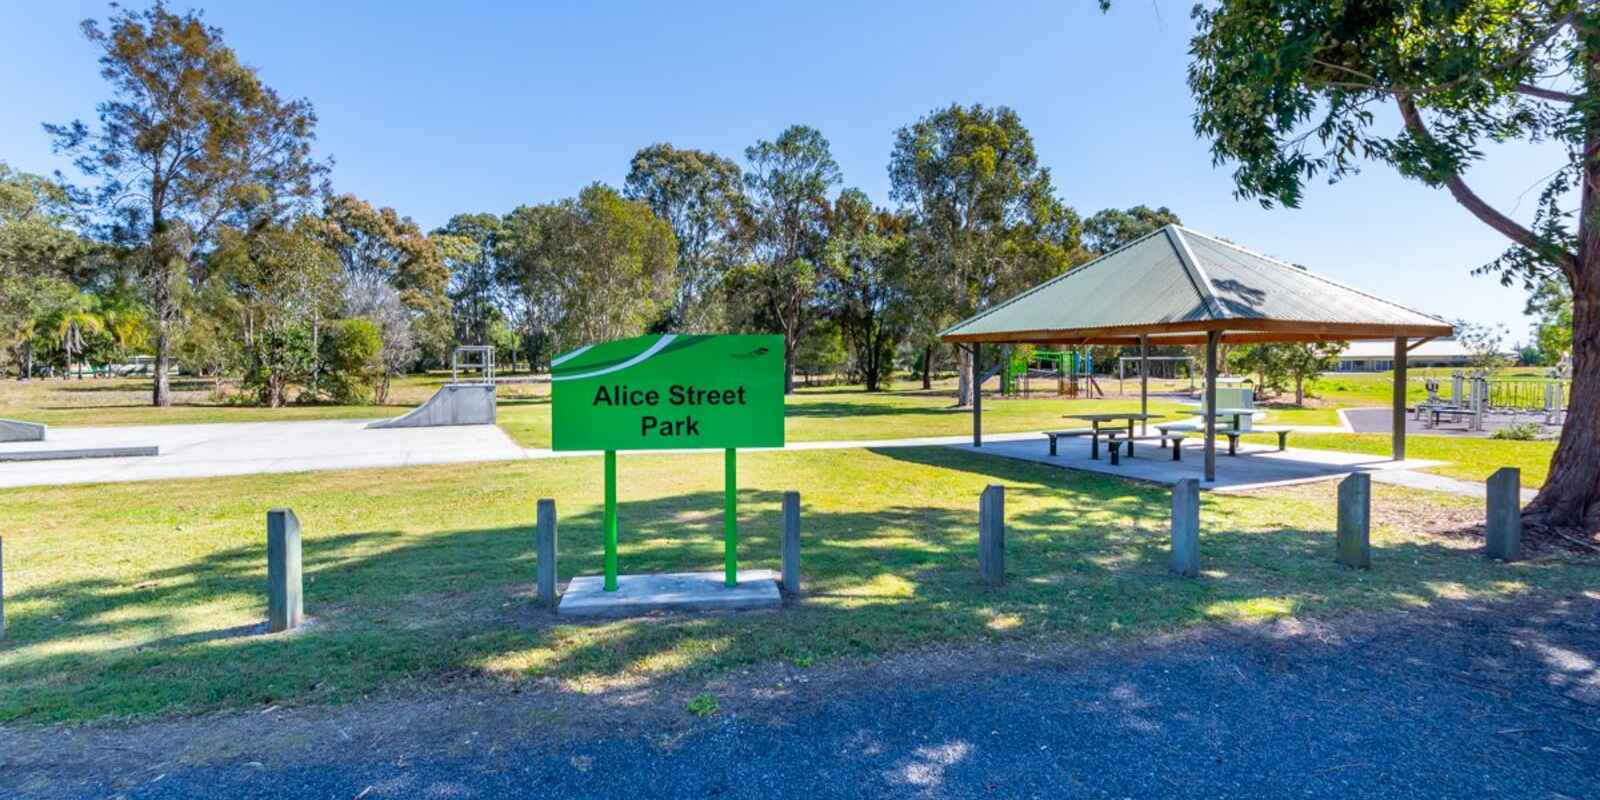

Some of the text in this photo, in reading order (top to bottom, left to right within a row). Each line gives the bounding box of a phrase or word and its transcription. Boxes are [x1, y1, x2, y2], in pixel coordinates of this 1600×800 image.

[593, 385, 747, 407] Alice Street
[640, 416, 700, 437] Park
